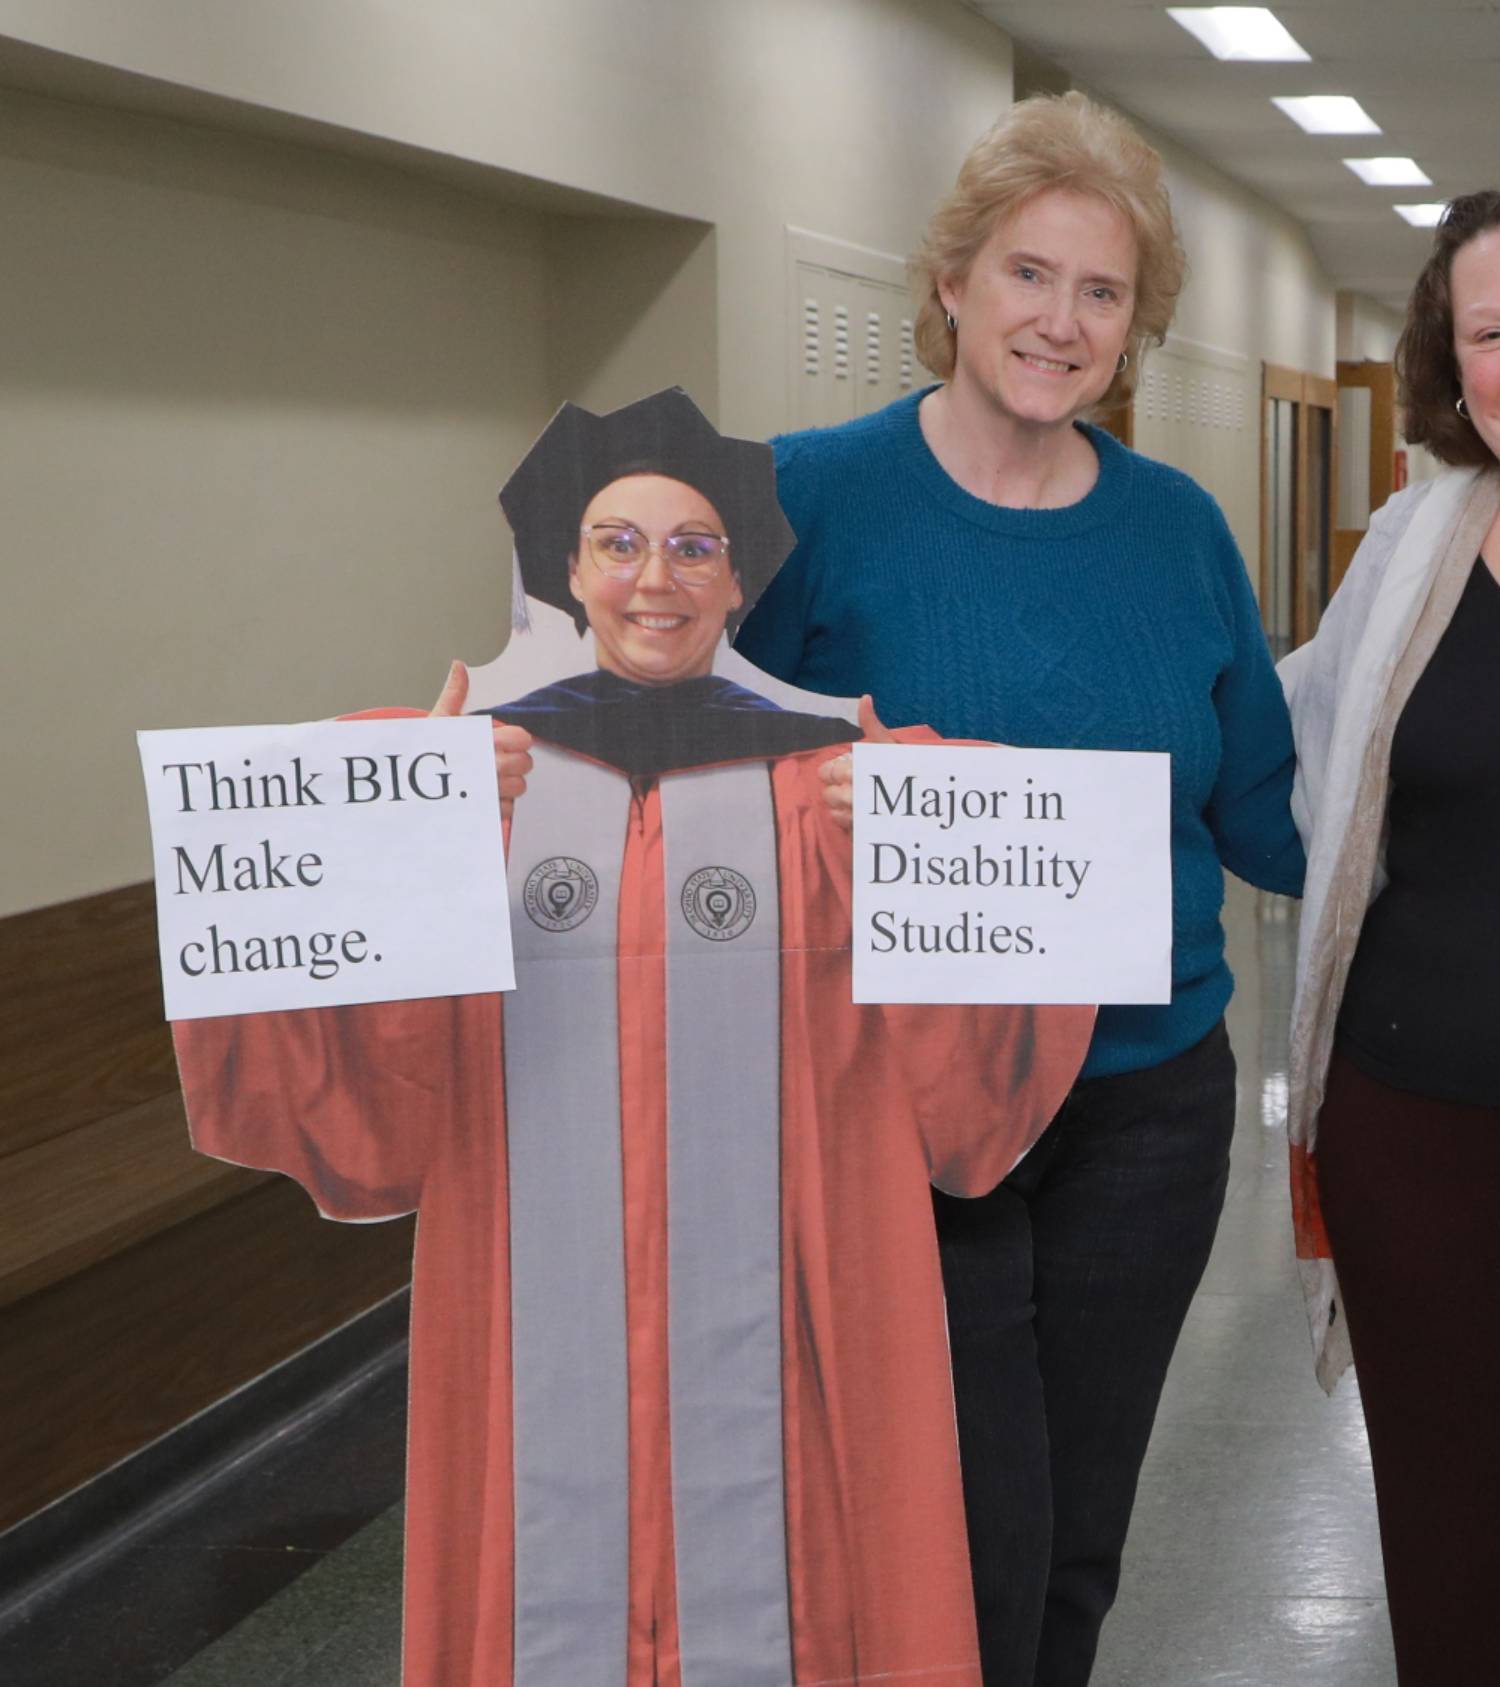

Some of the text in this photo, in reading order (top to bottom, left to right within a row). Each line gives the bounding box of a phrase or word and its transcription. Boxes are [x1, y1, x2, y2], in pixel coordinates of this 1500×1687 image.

[162, 751, 468, 812] Think BIG.
[869, 774, 1066, 830] Major in
[172, 839, 324, 895] Make
[869, 843, 1091, 899] Disability
[179, 924, 382, 981] change.
[870, 910, 1047, 954] Studies.
